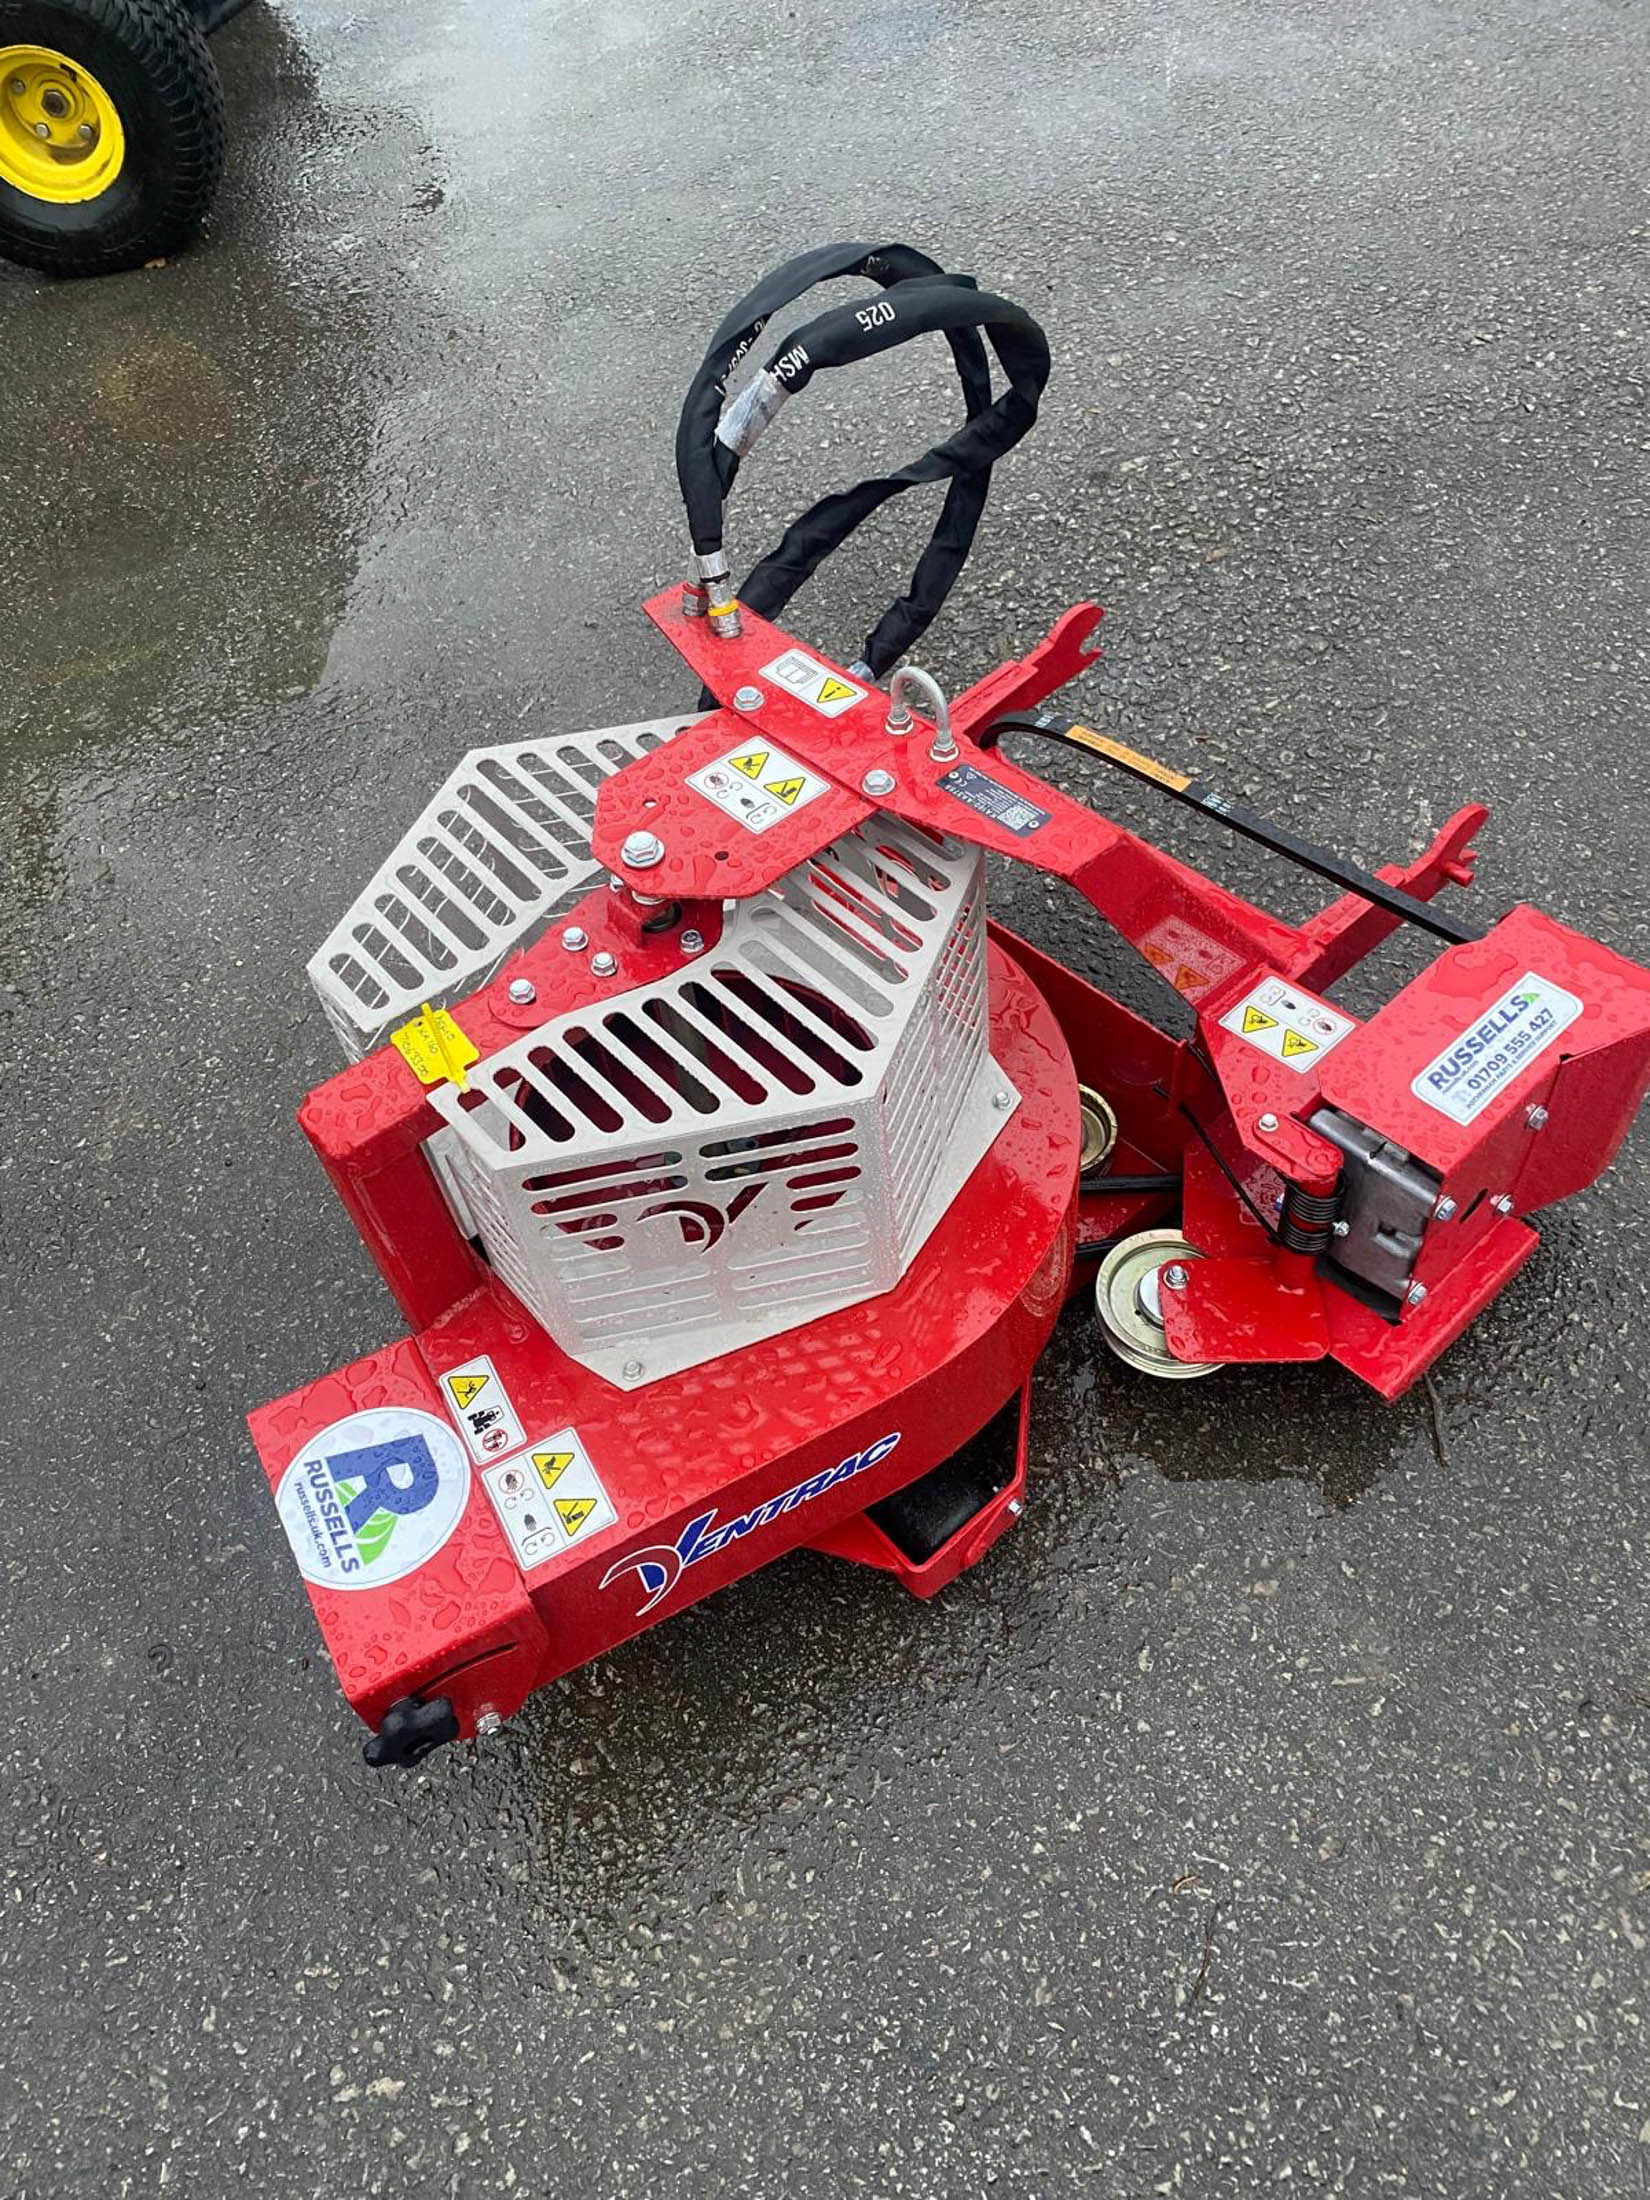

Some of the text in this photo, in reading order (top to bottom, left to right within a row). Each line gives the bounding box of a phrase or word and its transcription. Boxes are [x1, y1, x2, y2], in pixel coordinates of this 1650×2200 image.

[854, 300, 895, 331] 025
[1426, 992, 1530, 1090] RUSSELLS
[1467, 1008, 1554, 1090] 01709 555 427
[1534, 1019, 1557, 1041] SUPPORT
[294, 1482, 332, 1568] russells.uk.com
[303, 1460, 360, 1573] RUSSELLS
[326, 1434, 438, 1535] R
[599, 1432, 900, 1616] VENTRAC
